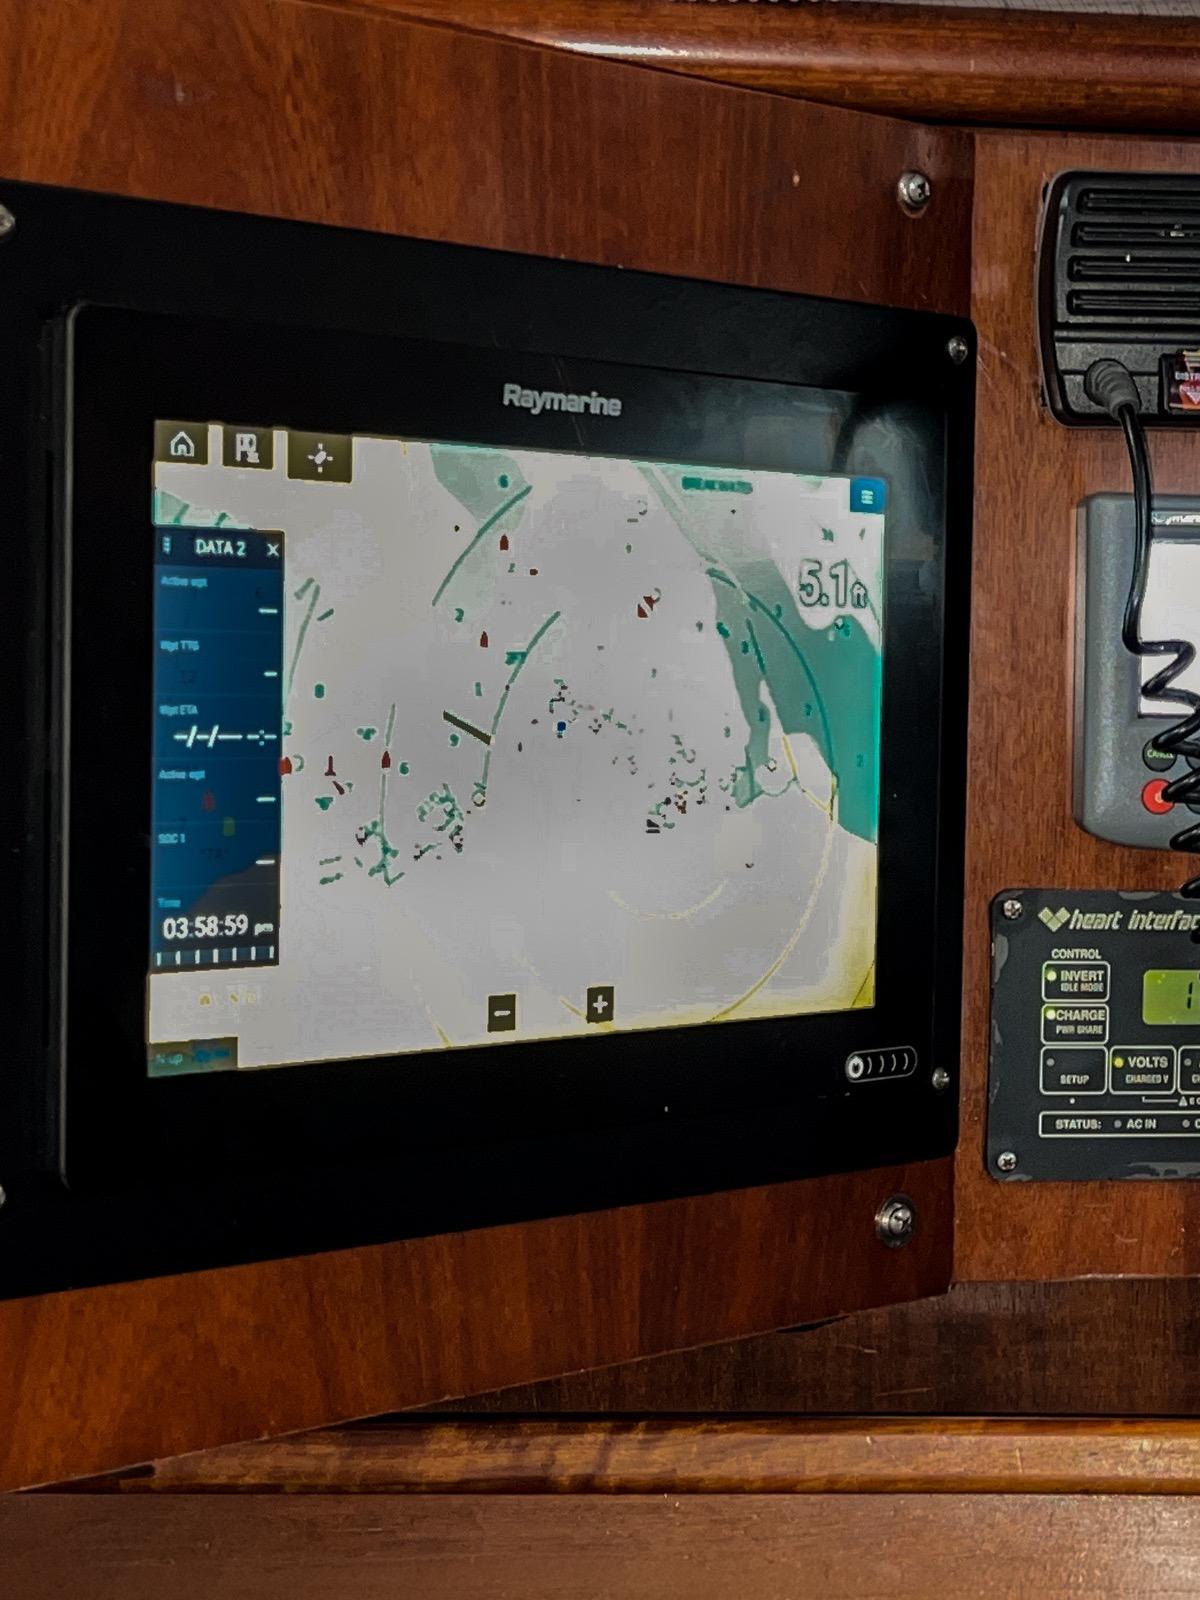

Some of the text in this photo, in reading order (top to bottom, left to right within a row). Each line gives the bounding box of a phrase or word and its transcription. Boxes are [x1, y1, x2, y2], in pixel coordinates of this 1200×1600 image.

[502, 383, 622, 416] Raymarine
[195, 538, 246, 557] DATA 2
[1069, 909, 1124, 930] heart
[163, 914, 249, 940] 03:58:59
[1051, 948, 1102, 959] CONTROL
[1060, 970, 1104, 981] INVERT
[1056, 1009, 1105, 1020] CHARGE
[1056, 1025, 1103, 1035] PWR SHARE
[1128, 1056, 1168, 1068] VOLTS
[1060, 1074, 1089, 1085] SETUP
[1125, 1074, 1159, 1084] CHARGED
[1055, 1119, 1102, 1130] STATUS:
[1126, 1119, 1157, 1130] AC IN
